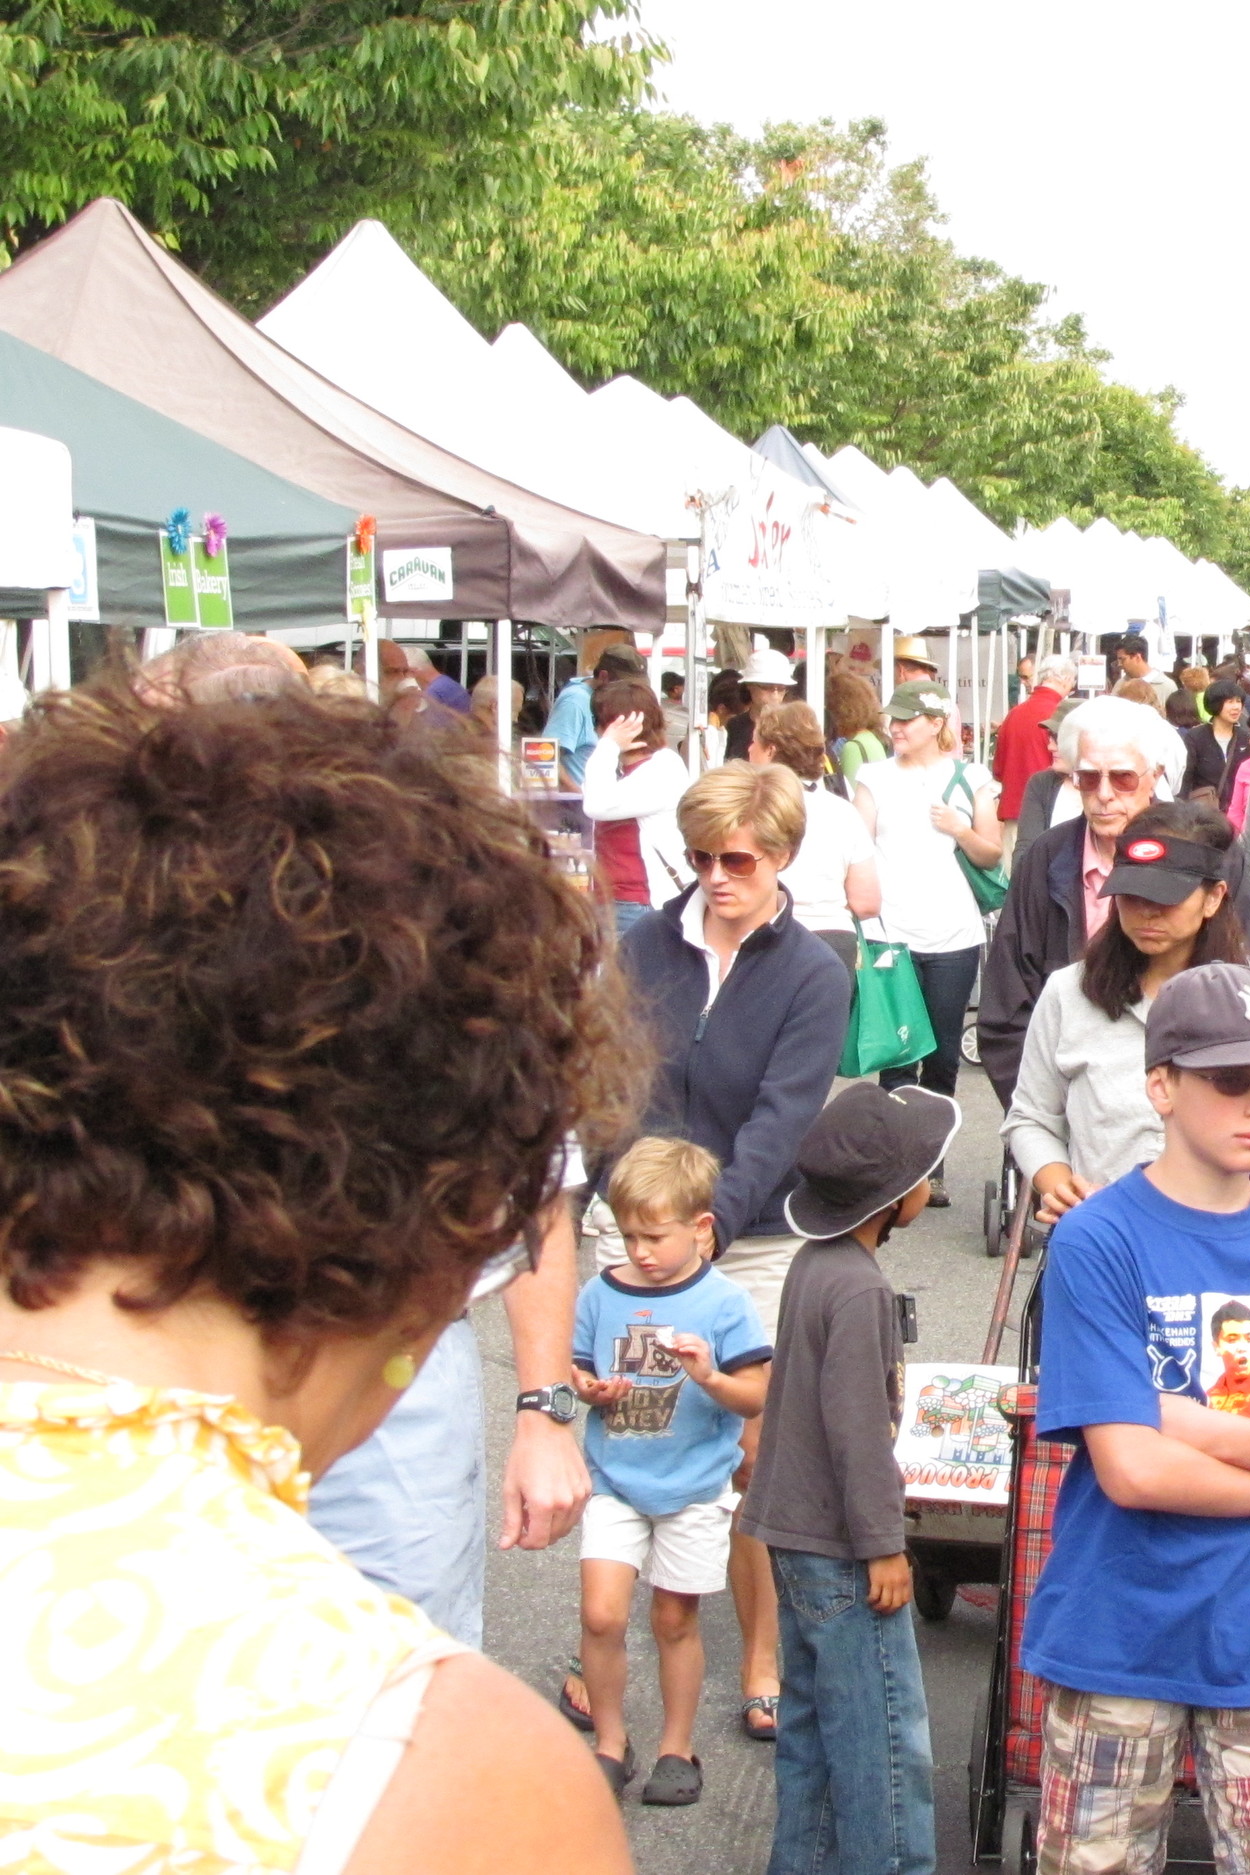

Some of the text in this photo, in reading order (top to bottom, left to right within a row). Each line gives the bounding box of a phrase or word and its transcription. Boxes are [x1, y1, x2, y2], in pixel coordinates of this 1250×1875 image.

[167, 562, 188, 587] Irish
[194, 568, 229, 600] Bakery
[389, 556, 446, 587] CARAVAN
